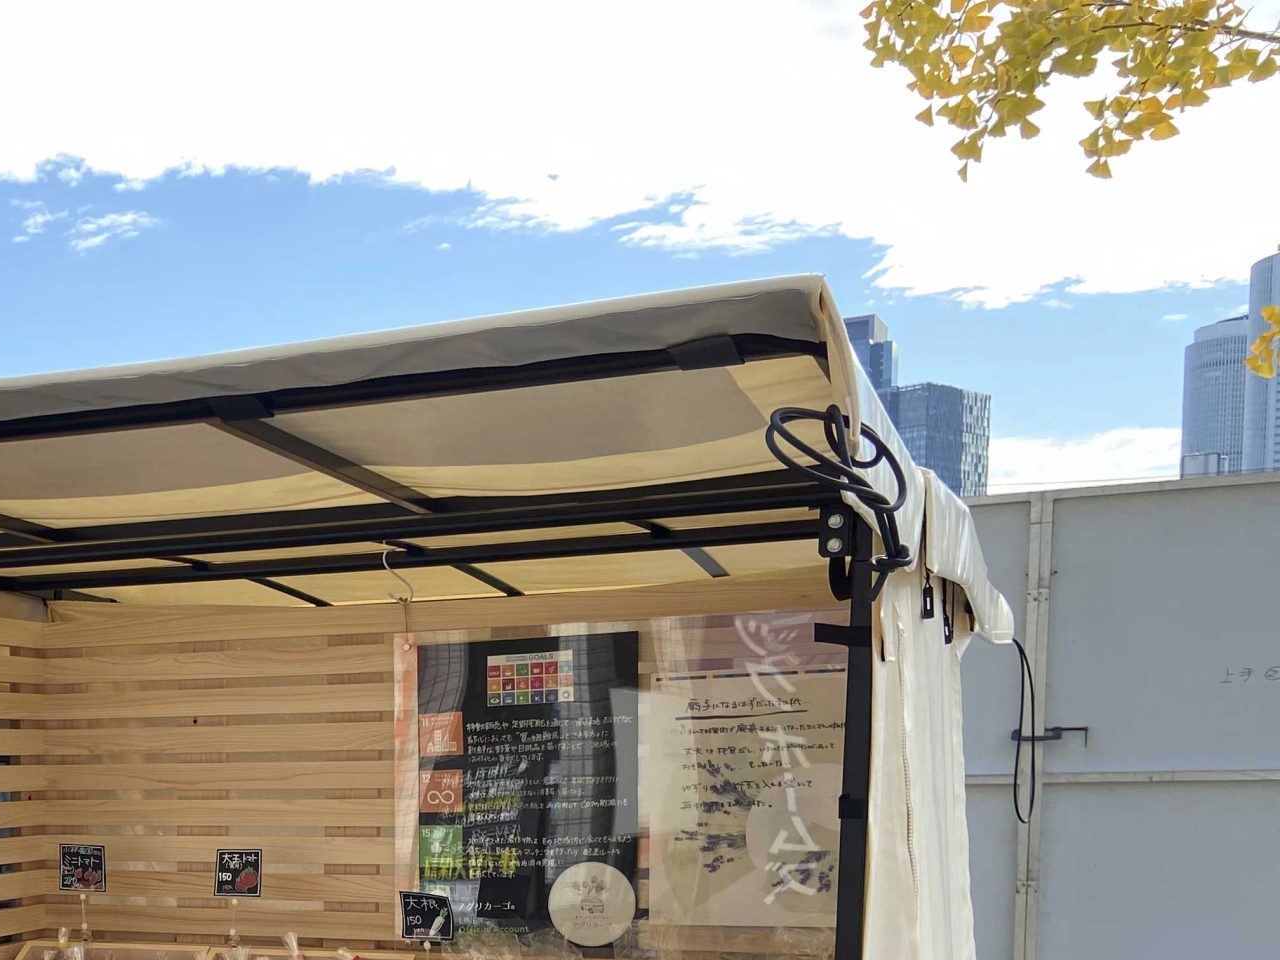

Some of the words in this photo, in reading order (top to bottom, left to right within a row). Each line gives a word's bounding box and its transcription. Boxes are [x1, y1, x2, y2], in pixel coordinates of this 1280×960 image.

[422, 773, 431, 783] 12
[422, 829, 431, 838] 15
[63, 854, 100, 868] ミニトマト
[221, 853, 258, 864] 大玉トマト
[219, 872, 232, 882] 150
[404, 897, 440, 911] 大根
[406, 914, 422, 926] 150
